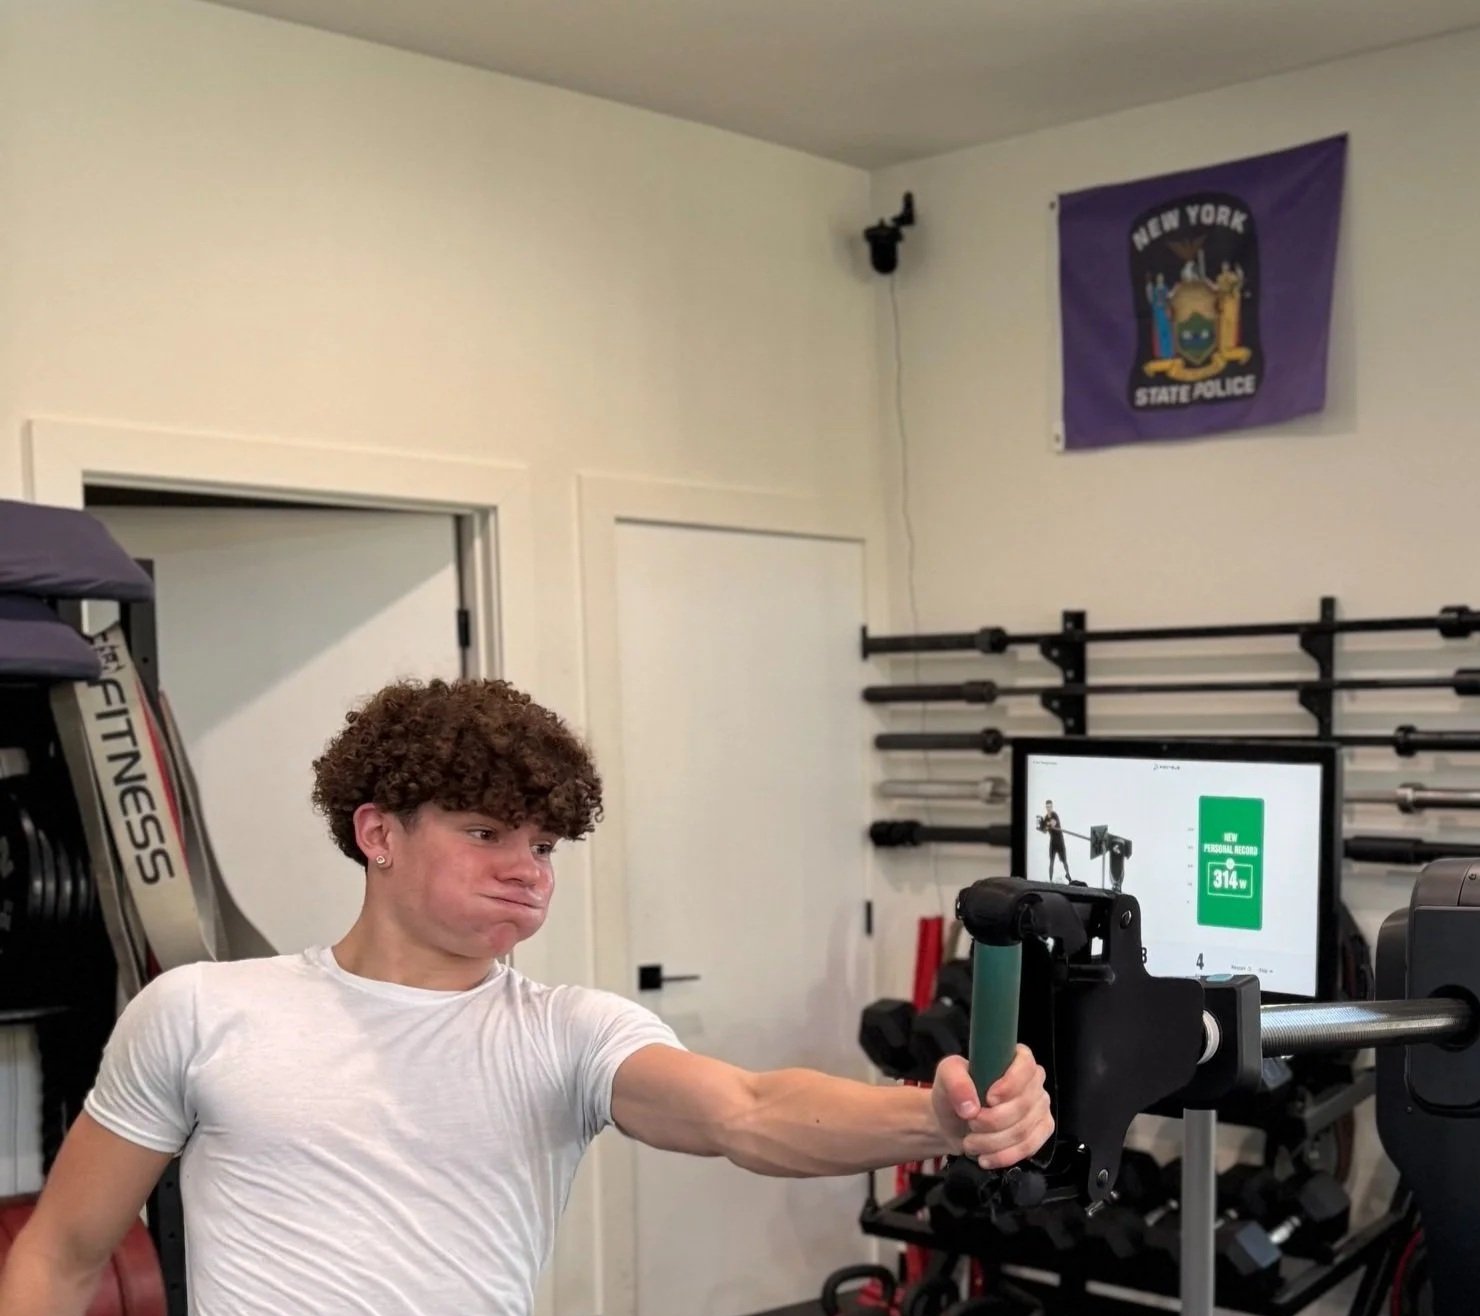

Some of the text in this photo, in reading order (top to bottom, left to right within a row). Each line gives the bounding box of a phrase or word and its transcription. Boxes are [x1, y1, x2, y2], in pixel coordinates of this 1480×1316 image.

[1133, 204, 1248, 252] NEW YORK
[1135, 375, 1255, 406] STATE POLICE
[87, 677, 175, 886] FITNESS
[1223, 832, 1239, 843] NEW
[1203, 843, 1233, 854] PERSONAL
[1234, 845, 1258, 856] RECORD
[1213, 869, 1238, 889] 314
[1196, 953, 1204, 970] 4
